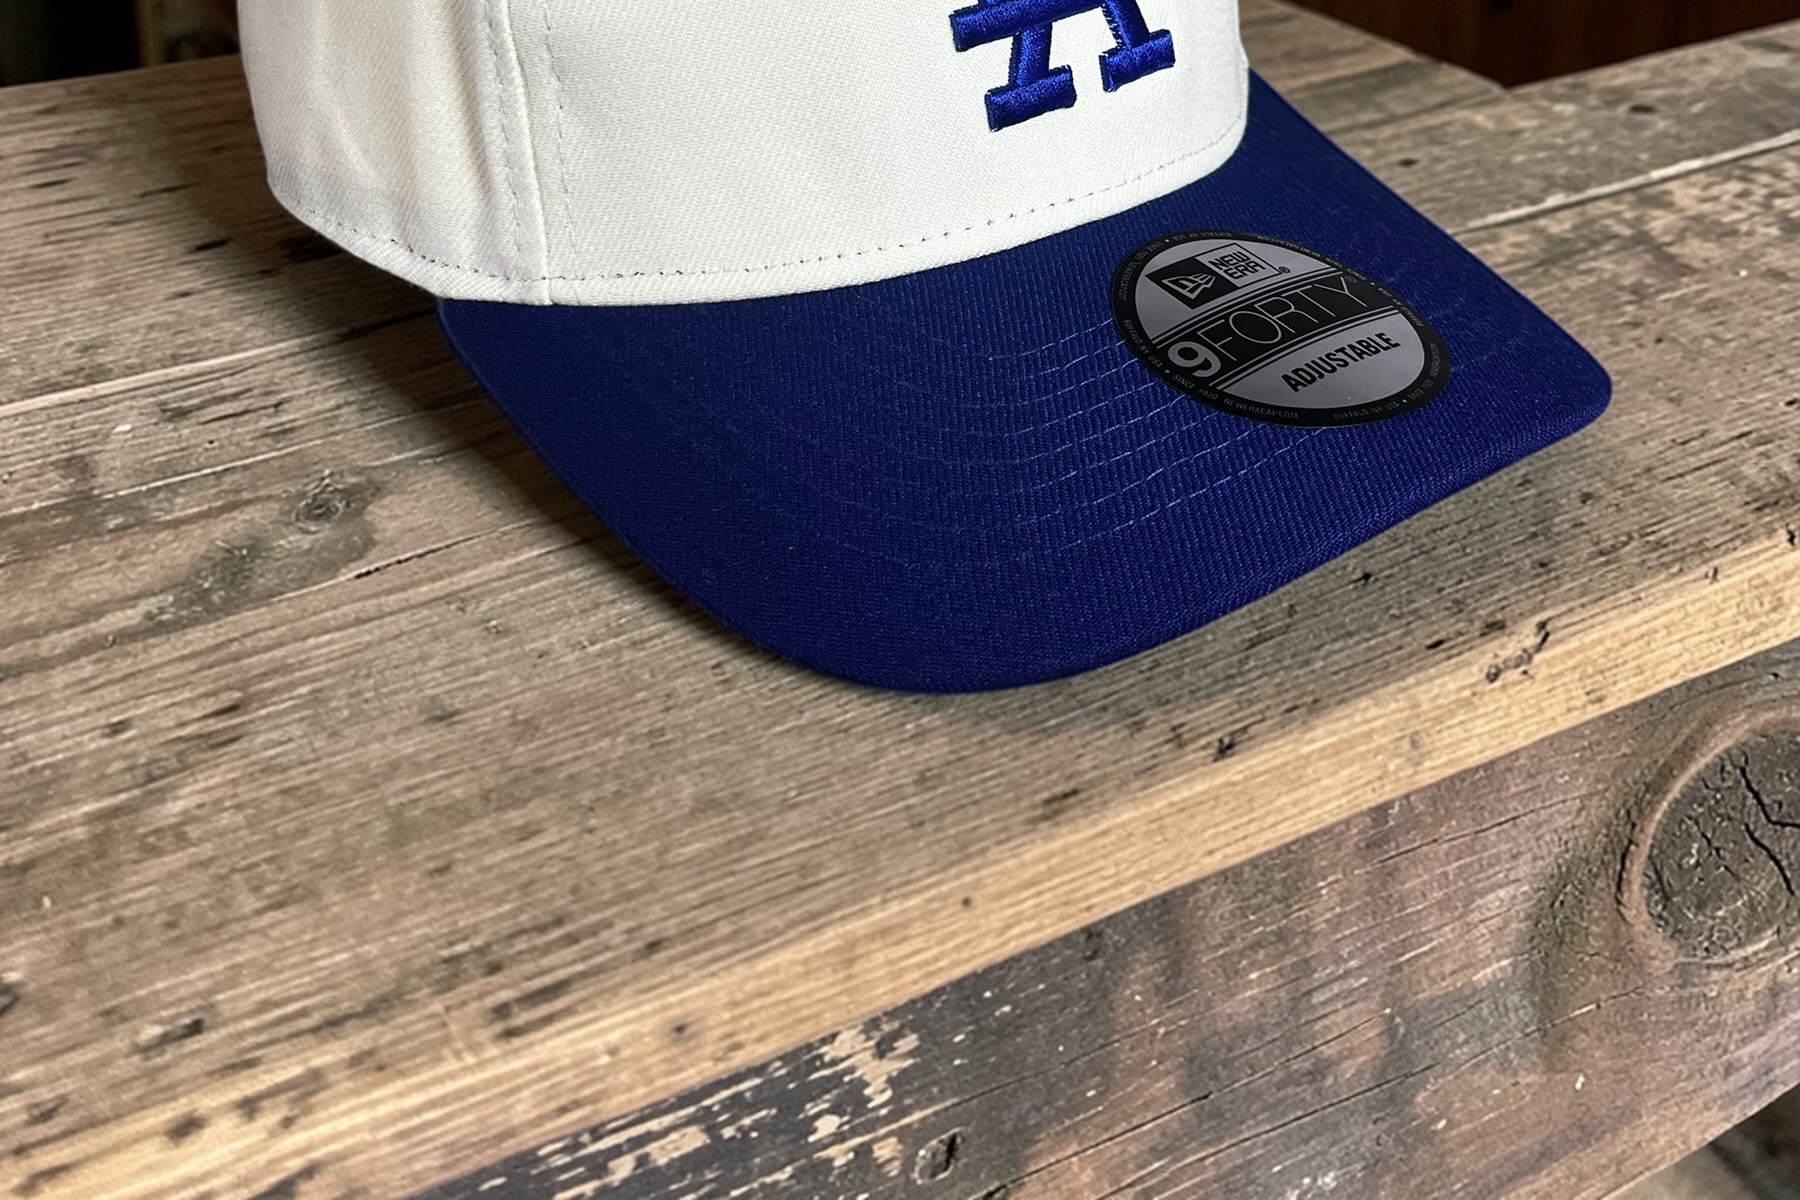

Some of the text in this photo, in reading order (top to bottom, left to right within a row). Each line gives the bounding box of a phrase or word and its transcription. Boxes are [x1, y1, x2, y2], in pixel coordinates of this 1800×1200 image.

[1208, 251, 1251, 271] NEW
[1223, 262, 1266, 280] ERA
[1167, 276, 1368, 378] 9FORTY
[1281, 332, 1401, 392] ADJUSTABLE
[1172, 373, 1196, 391] SINCE
[1198, 388, 1219, 402] 1920
